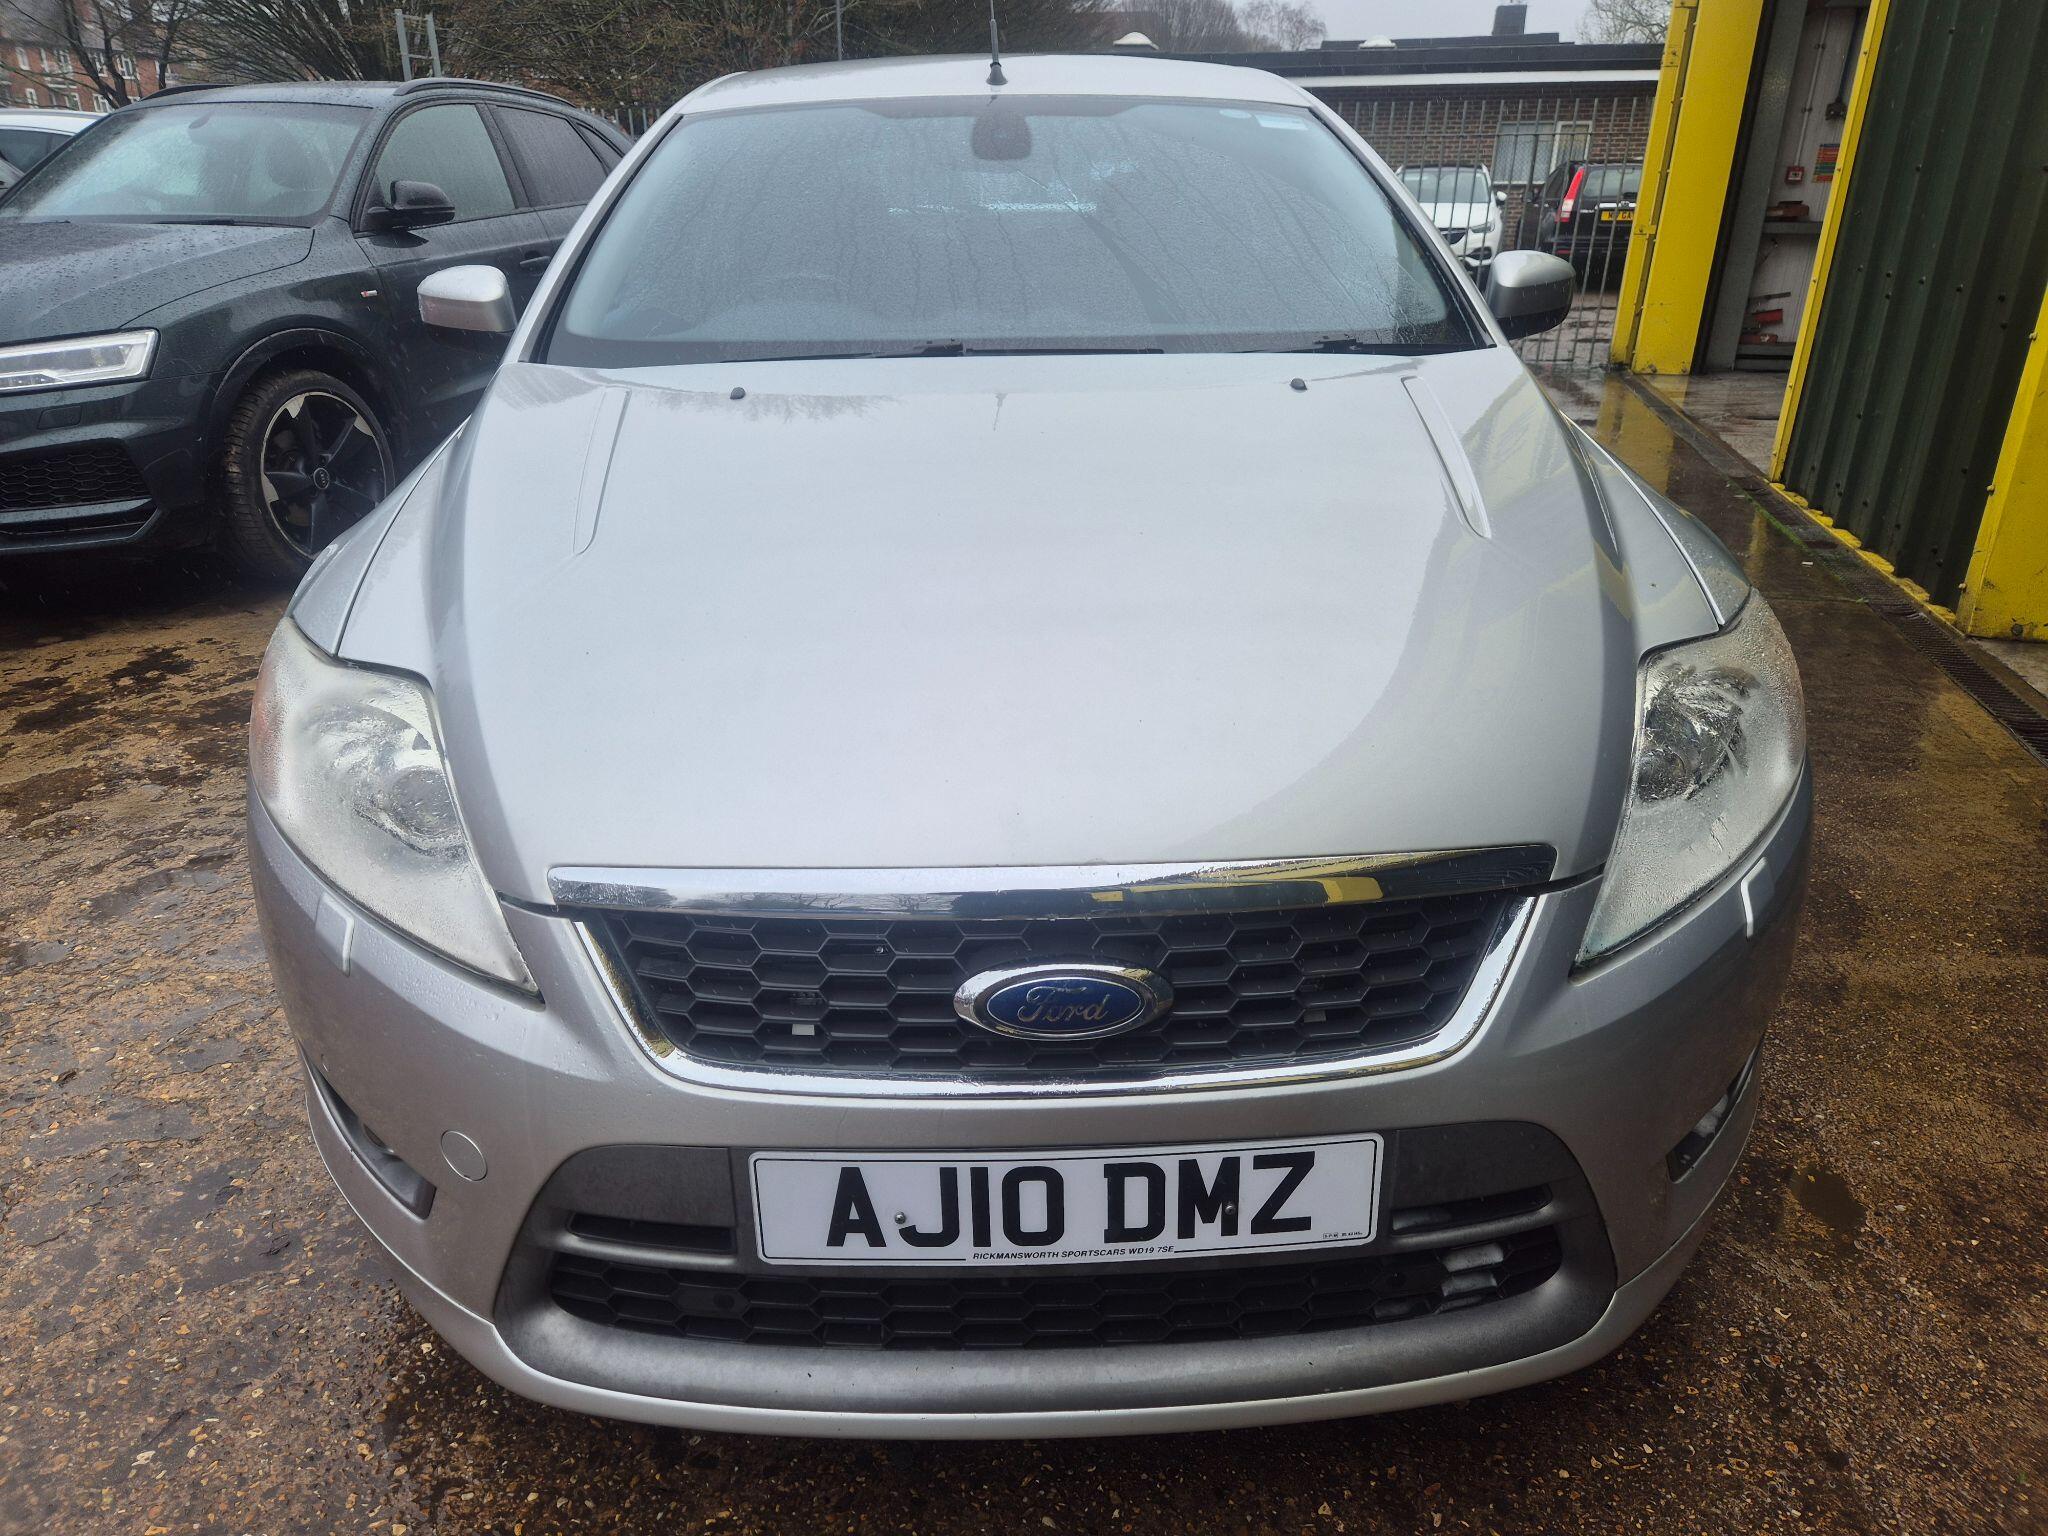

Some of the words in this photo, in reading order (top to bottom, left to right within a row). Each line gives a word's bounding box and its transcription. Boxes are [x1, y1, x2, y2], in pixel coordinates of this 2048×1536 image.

[1017, 985, 1111, 1023] Ford
[826, 1165, 1065, 1248] AJ10
[1103, 1150, 1316, 1244] DMZ
[973, 1251, 1060, 1260] RICKMANSWORTH
[1061, 1248, 1126, 1258] SPORTSCARS
[1128, 1246, 1155, 1255] WD19
[1157, 1245, 1175, 1253] 7SE
